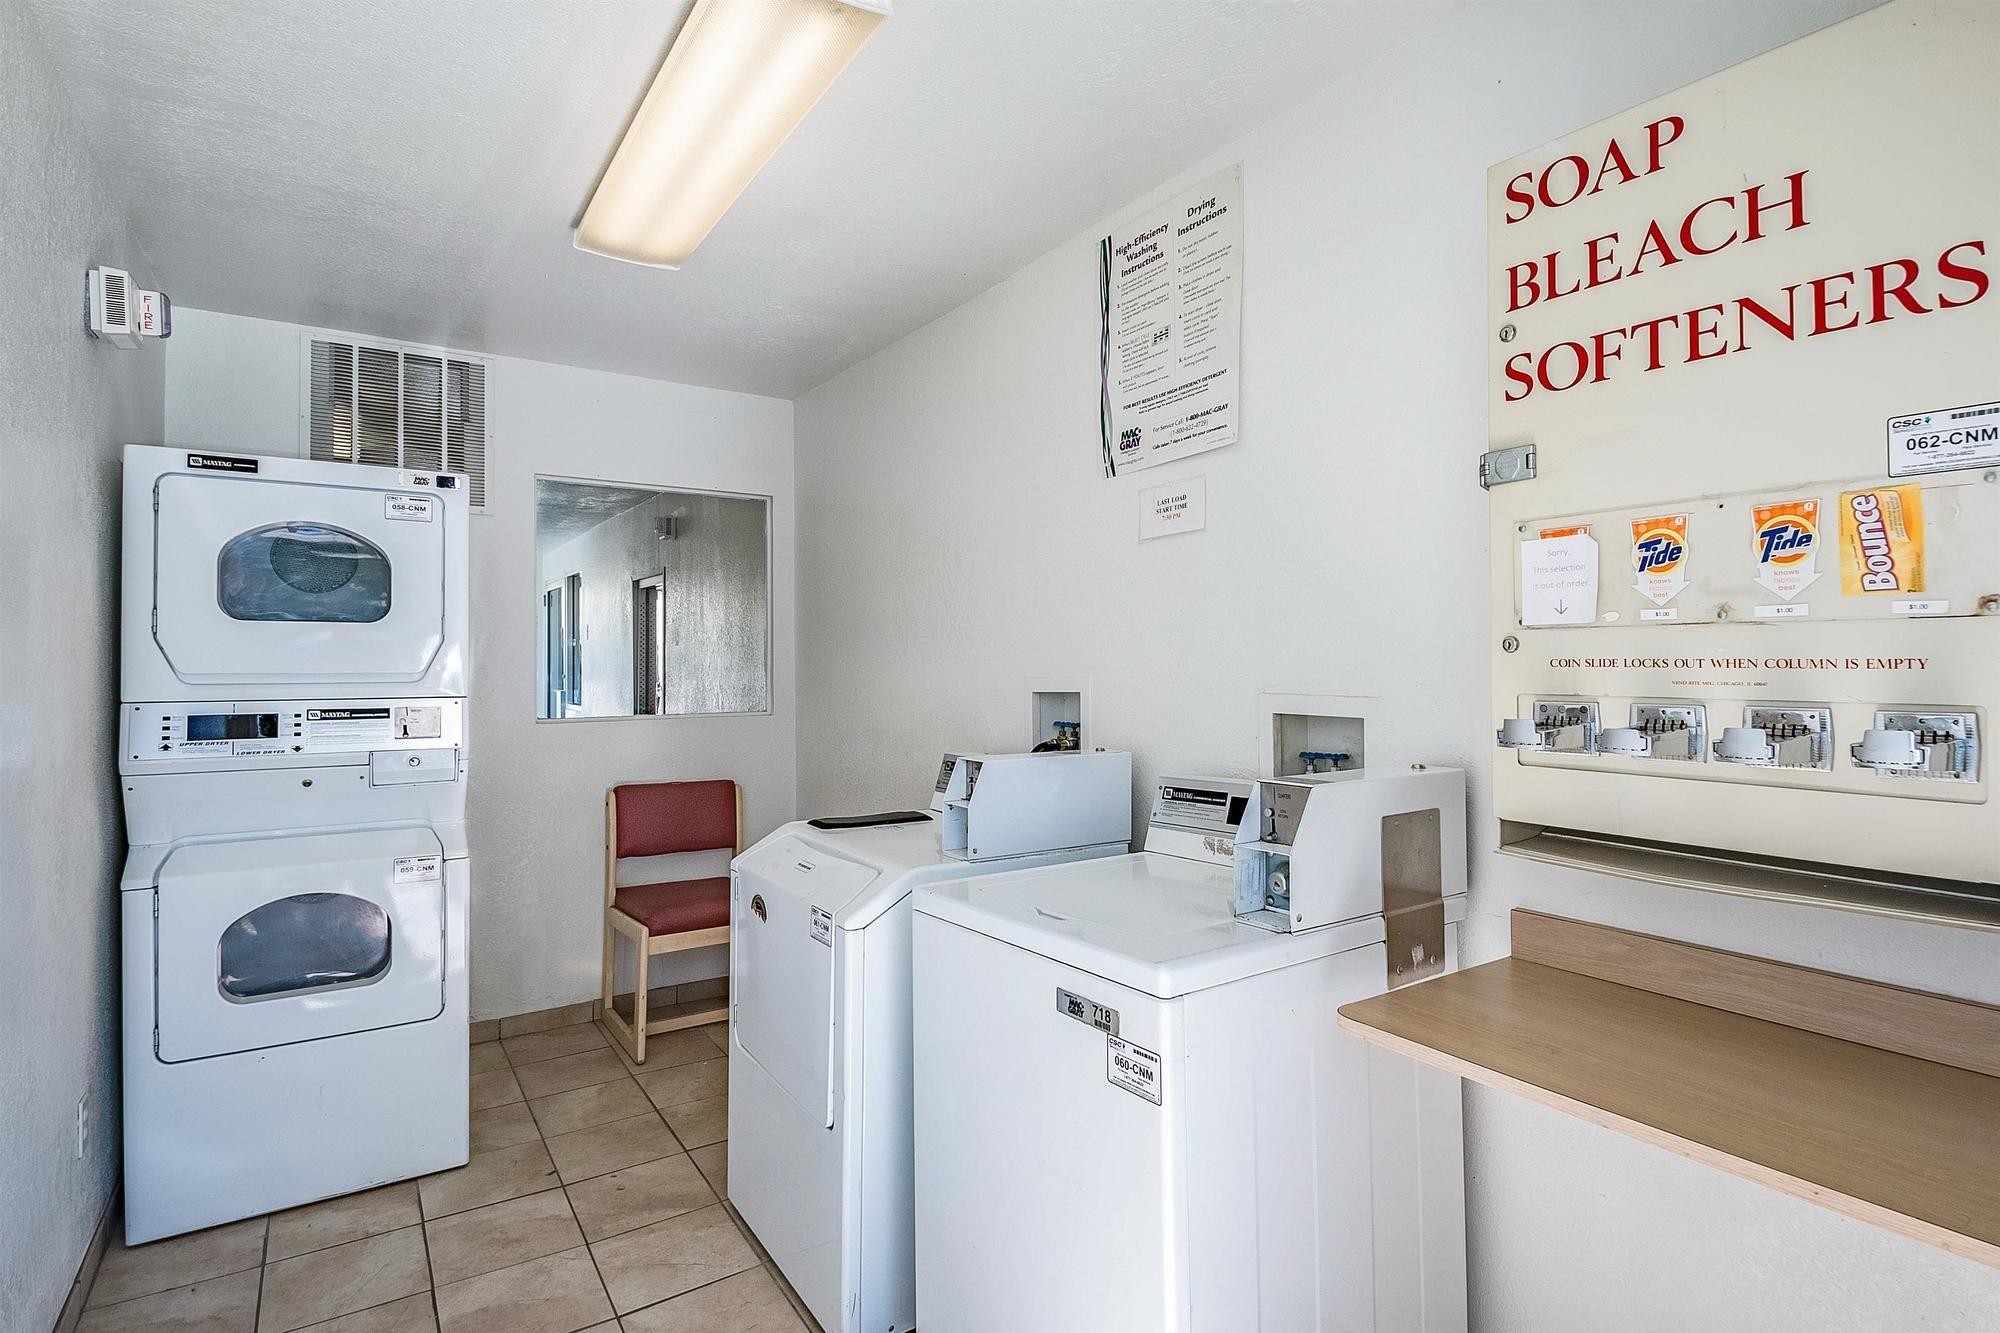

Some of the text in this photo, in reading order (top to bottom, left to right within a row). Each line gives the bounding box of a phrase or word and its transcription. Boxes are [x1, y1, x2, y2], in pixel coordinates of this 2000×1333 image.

[1505, 115, 1685, 225] SOAP
[1187, 197, 1216, 218] Drying
[1177, 206, 1228, 237] Instructions
[1115, 223, 1169, 257] High-Efficiency
[1505, 170, 1811, 313] BLEACH
[1126, 242, 1158, 262] Washing
[1121, 251, 1165, 278] Instructions
[143, 295, 153, 330] FIRE
[1505, 240, 1989, 401] SOFTENERS
[1123, 403, 1131, 411] FOR
[1141, 395, 1158, 404] RESULTS
[1202, 368, 1228, 383] DETERGENT
[1160, 422, 1174, 431] Service
[1185, 403, 1229, 422] 1-800-MAC-GRAY
[1892, 418, 1922, 429] CSC
[1119, 436, 1141, 451] GRAY
[1198, 430, 1206, 438] your
[1906, 427, 1998, 451] 062-CNM
[202, 459, 232, 467] MAYTAG
[391, 504, 427, 512] 058-CNM
[1156, 503, 1188, 514] START TIME
[1157, 494, 1187, 506] LAST LOAD
[1759, 524, 1813, 564] Tide
[1851, 493, 1900, 592] Bounce
[1637, 538, 1683, 573] Tide
[1533, 564, 1586, 575] This selection
[1533, 583, 1540, 591] is
[1541, 581, 1554, 590] out
[1555, 579, 1564, 589] of
[1778, 583, 1796, 591] best
[1550, 658, 1929, 669] COIN SLIDE LOCKS OUT WHEN COLUMN IS EMPTY
[321, 711, 350, 719] MAYTAG
[1172, 790, 1194, 799] MAYTAG
[400, 864, 435, 873] 059CNM
[1092, 1003, 1111, 1024] 718
[1109, 1037, 1122, 1049] CSC
[1114, 1055, 1154, 1083] 060-CNM
